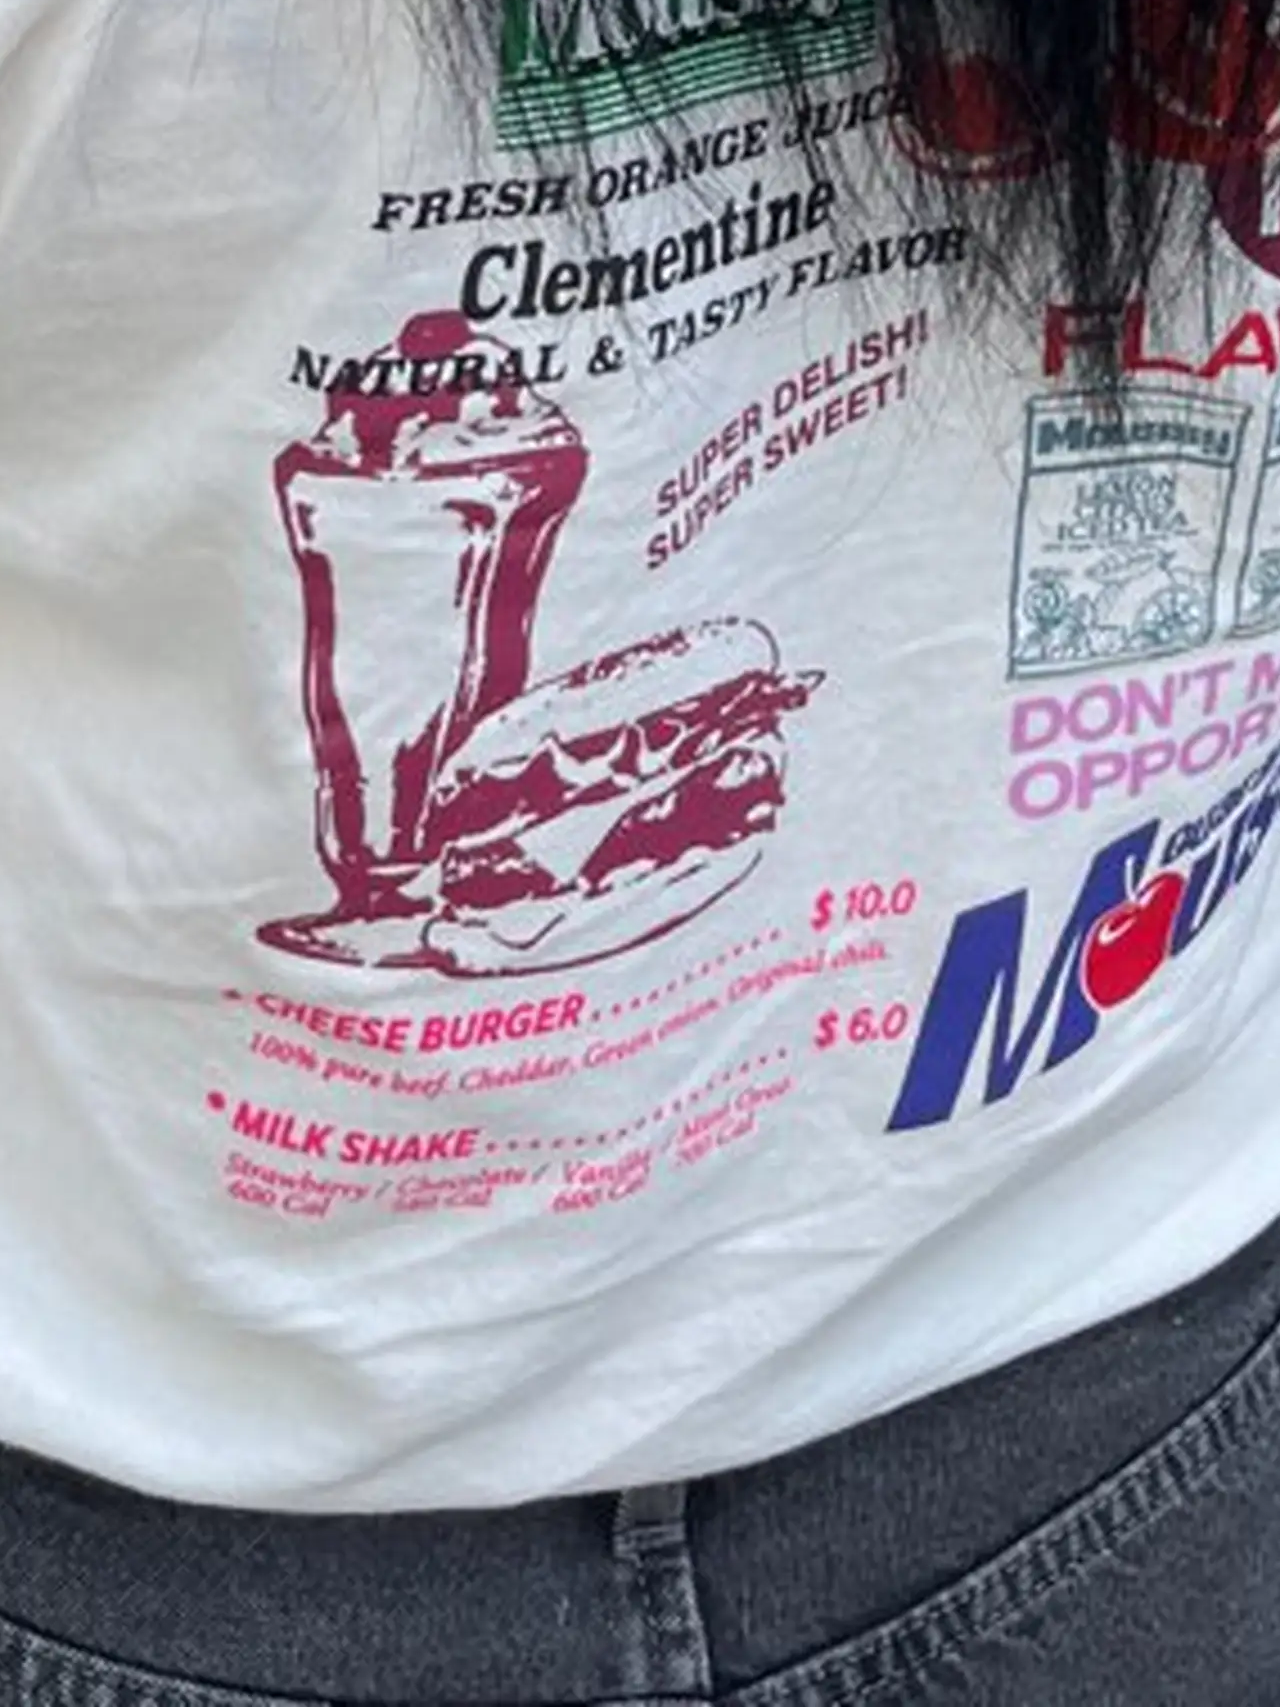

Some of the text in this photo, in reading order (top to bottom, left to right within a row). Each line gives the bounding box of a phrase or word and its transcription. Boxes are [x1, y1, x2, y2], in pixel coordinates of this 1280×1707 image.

[371, 173, 570, 231] FRESH
[586, 118, 769, 208] ORANGE
[460, 180, 836, 322] Clementine
[288, 227, 967, 398] NATURAL & TASTY FLAVOR
[646, 362, 909, 570] SUPER SWEET!
[655, 308, 929, 518] SUPER DELISH!
[1009, 660, 1236, 756] DON'T
[249, 1031, 320, 1072] 100%
[254, 990, 411, 1054] CHEESE
[419, 991, 587, 1052] BURGER
[231, 1100, 336, 1158] MILK
[338, 1127, 481, 1167] SHAKE
